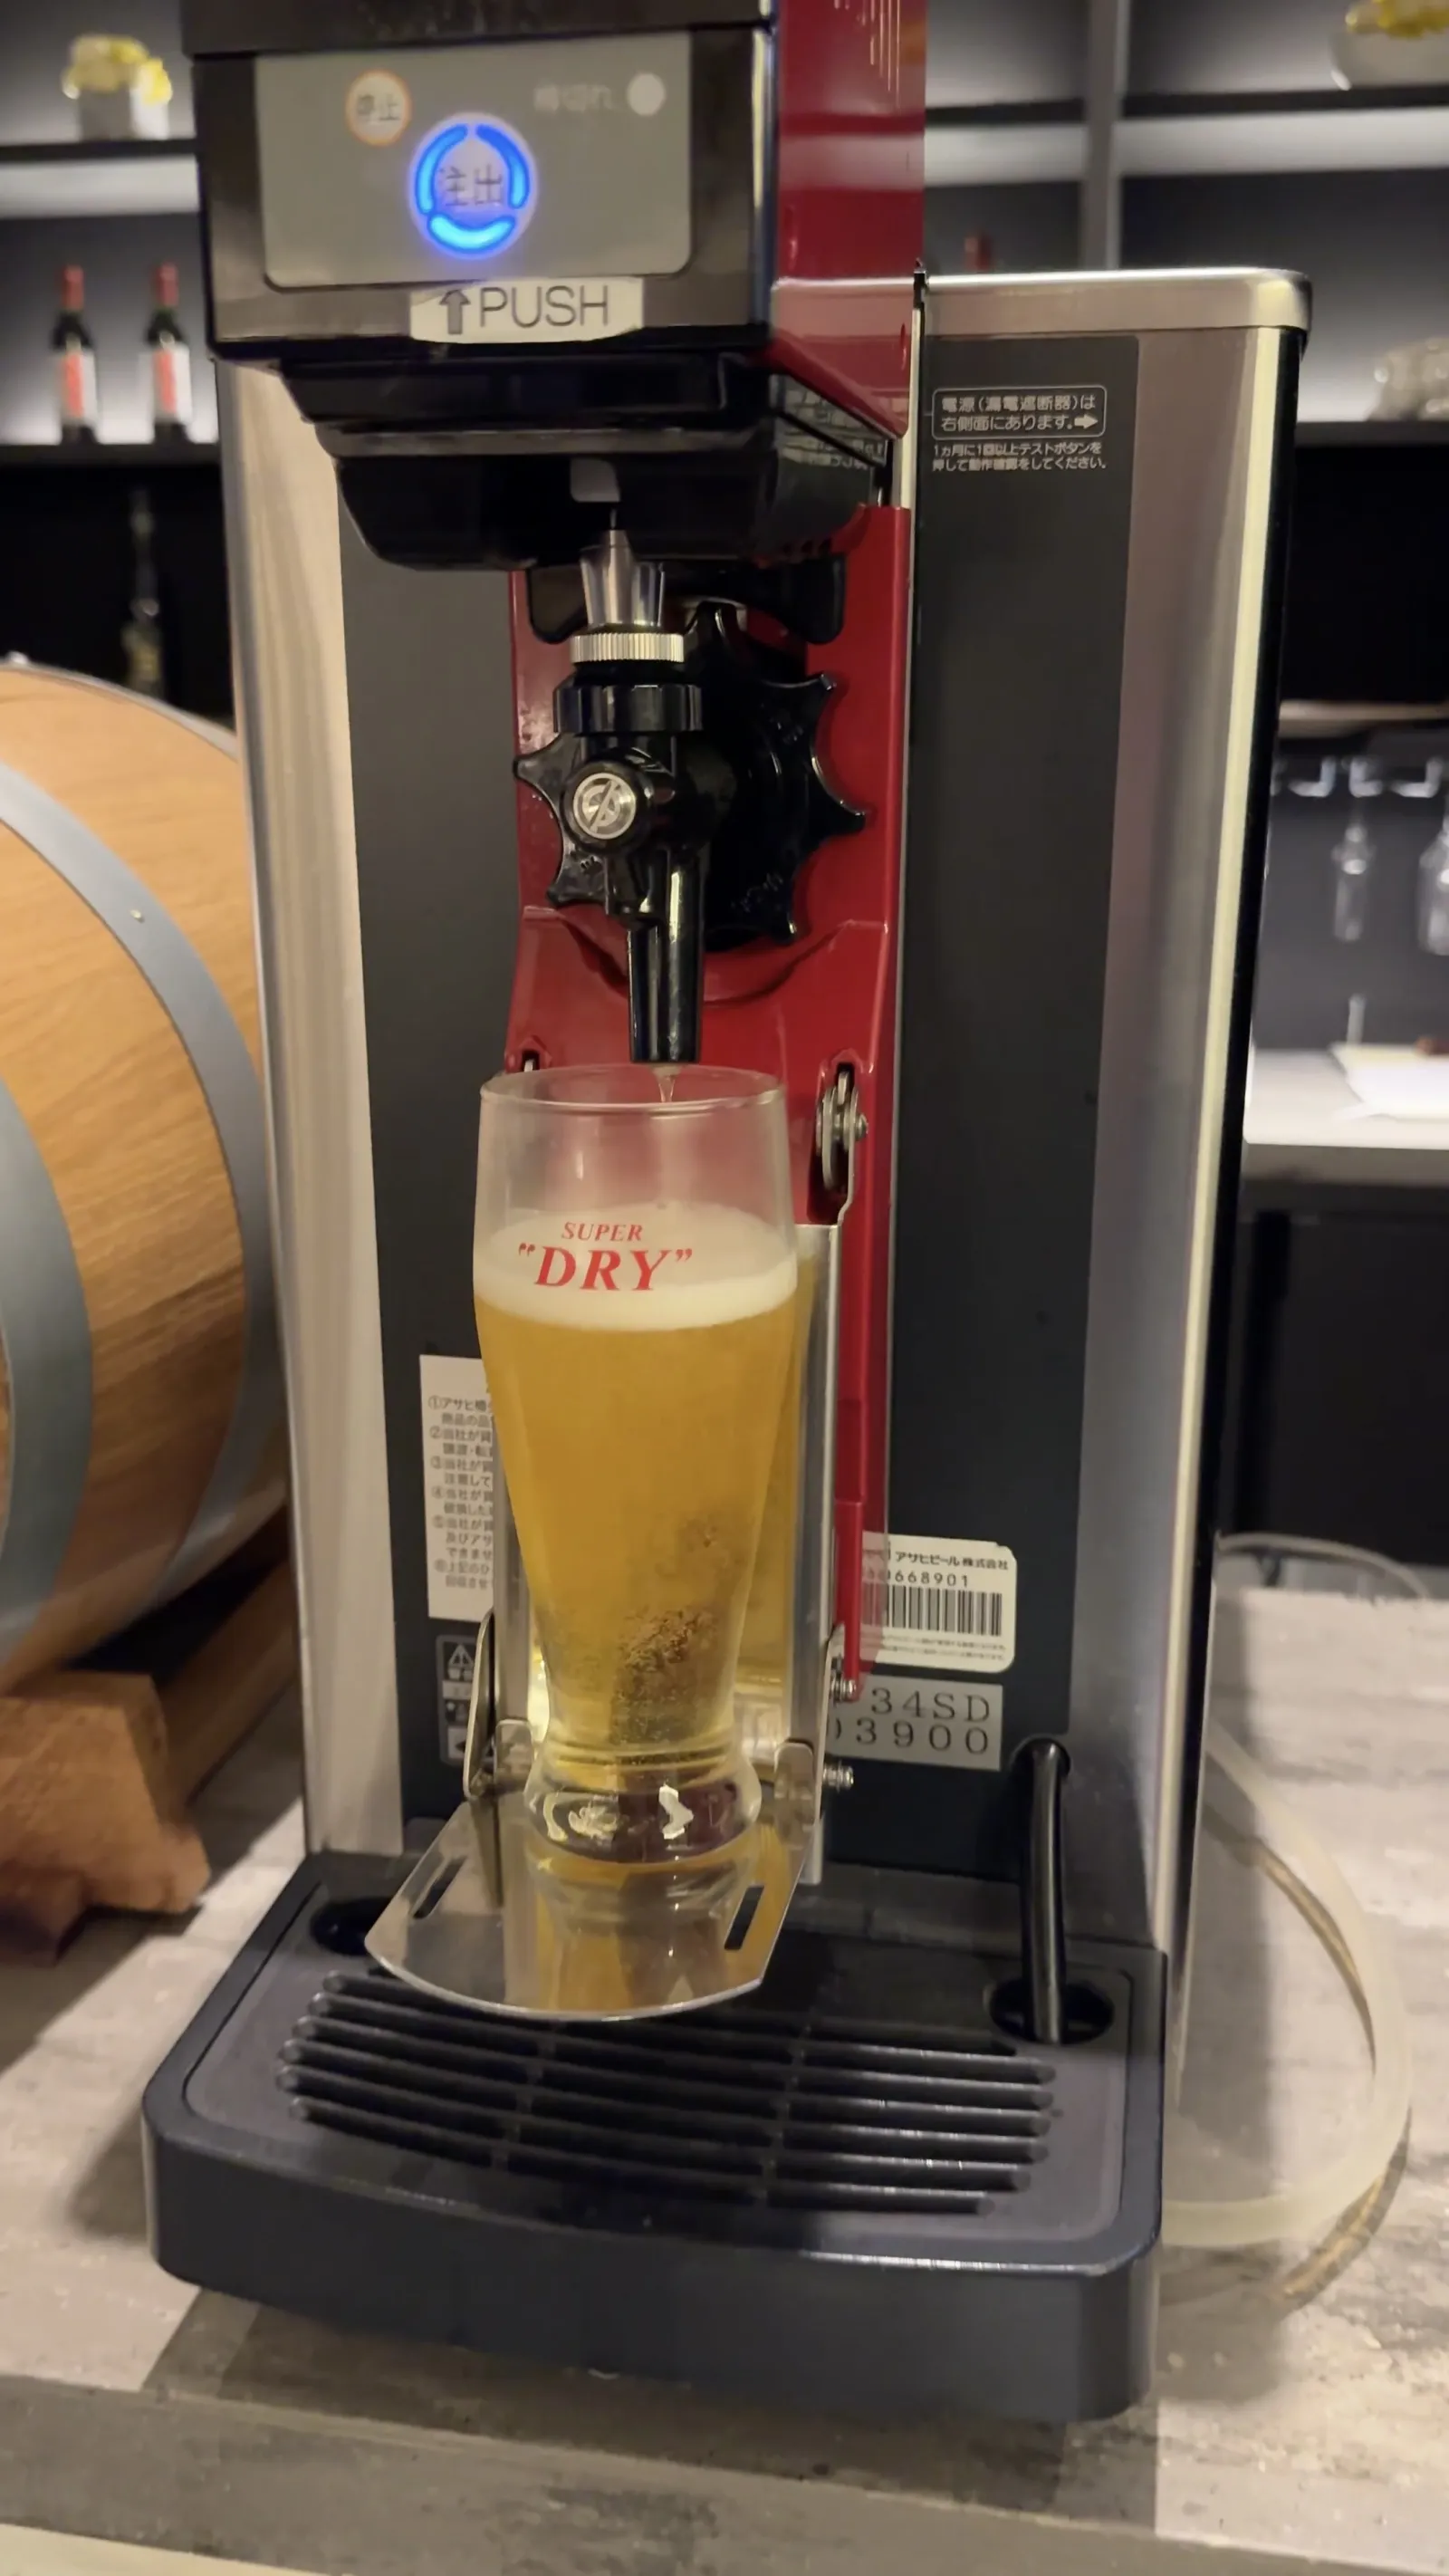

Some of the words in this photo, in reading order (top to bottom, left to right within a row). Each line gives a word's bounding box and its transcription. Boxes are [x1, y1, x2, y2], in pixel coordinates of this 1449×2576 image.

[439, 164, 503, 207] 注出
[480, 285, 609, 328] PUSH
[561, 1222, 643, 1242] SUPER
[887, 1569, 968, 1588] 668901
